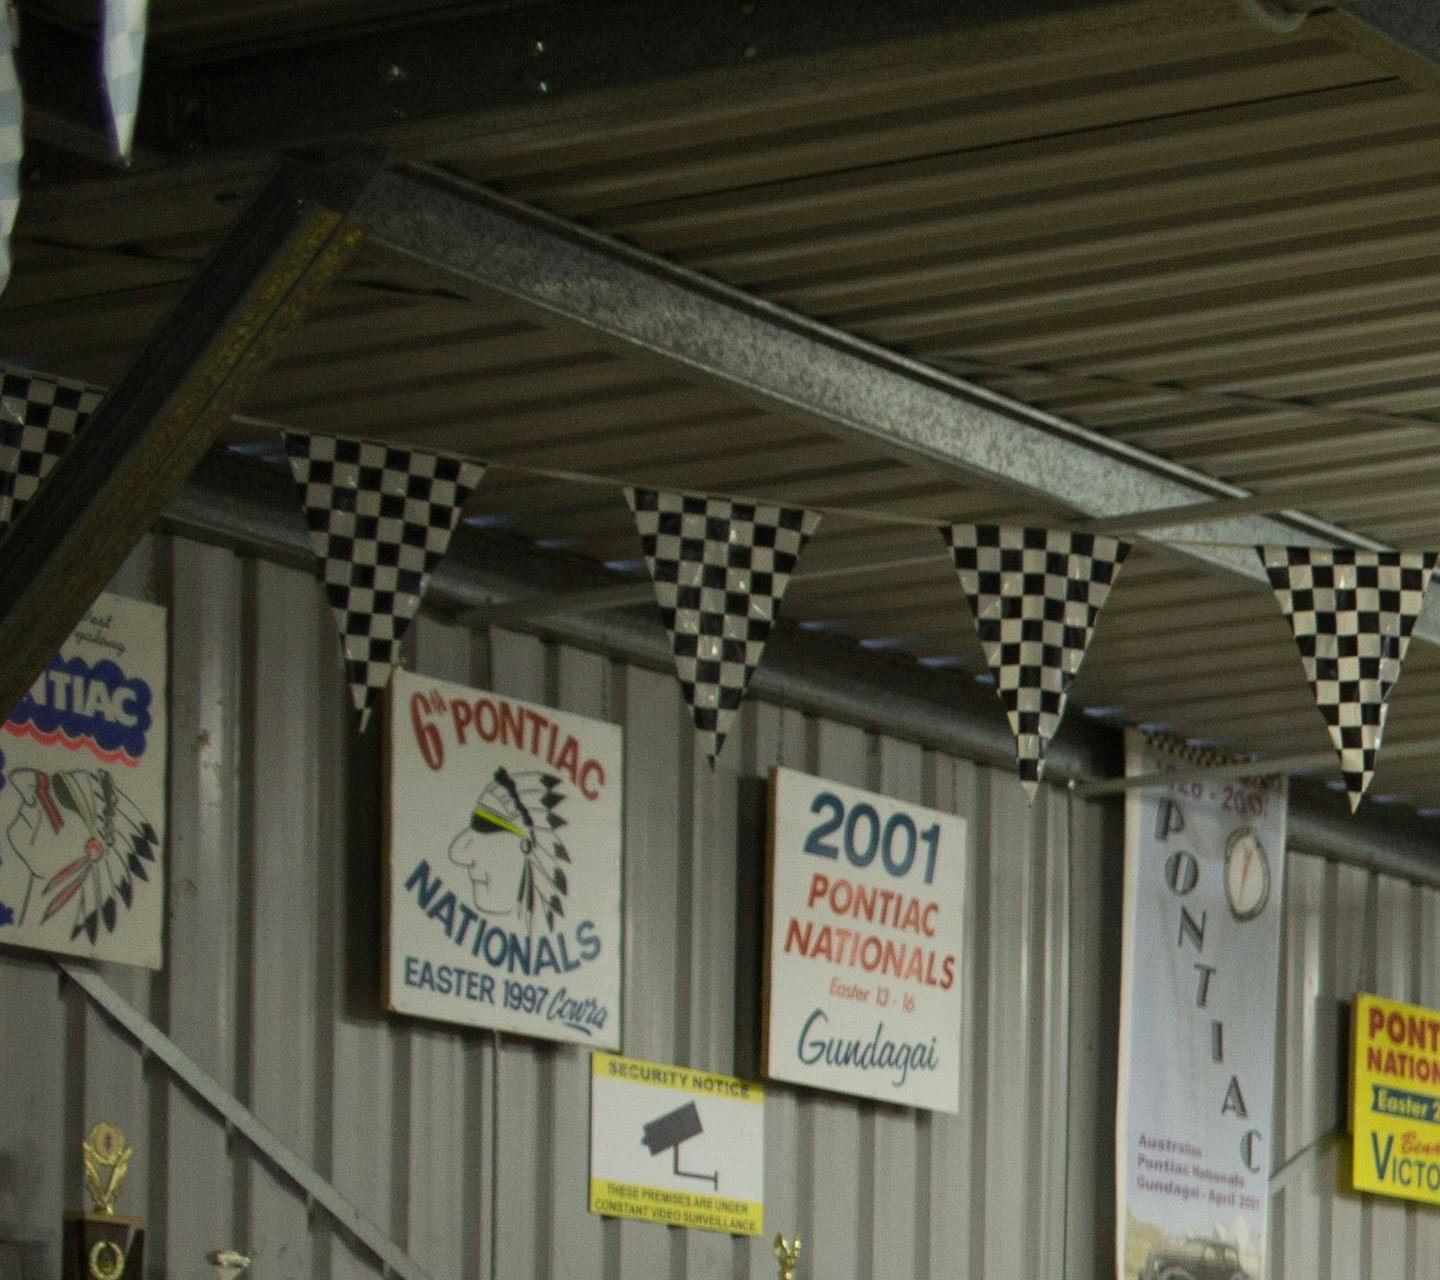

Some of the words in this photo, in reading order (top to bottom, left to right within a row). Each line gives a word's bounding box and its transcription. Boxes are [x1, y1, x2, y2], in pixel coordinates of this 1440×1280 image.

[452, 696, 606, 800] PONTIAC
[803, 790, 941, 885] 2001
[404, 860, 602, 976] NATIONALS
[806, 873, 940, 938] PONTIAC
[783, 917, 955, 991] NATIONALS
[403, 957, 498, 1007] EASTER
[502, 980, 548, 1016] 1997
[547, 986, 608, 1039] Cowra
[828, 977, 870, 1009] Easter
[874, 985, 891, 1007] 13
[901, 992, 916, 1013] 16
[608, 1061, 689, 1089] SECURITY
[692, 1076, 750, 1098] NOTICE
[797, 1010, 940, 1088] Gundagai
[1376, 1089, 1429, 1123] Easter
[594, 1199, 648, 1216] CONSTANT
[650, 1205, 681, 1221] VIDEO
[606, 1184, 640, 1198] THESE
[641, 1187, 691, 1206] PREMISES
[693, 1194, 713, 1209] ARE
[714, 1198, 748, 1214] UNDER
